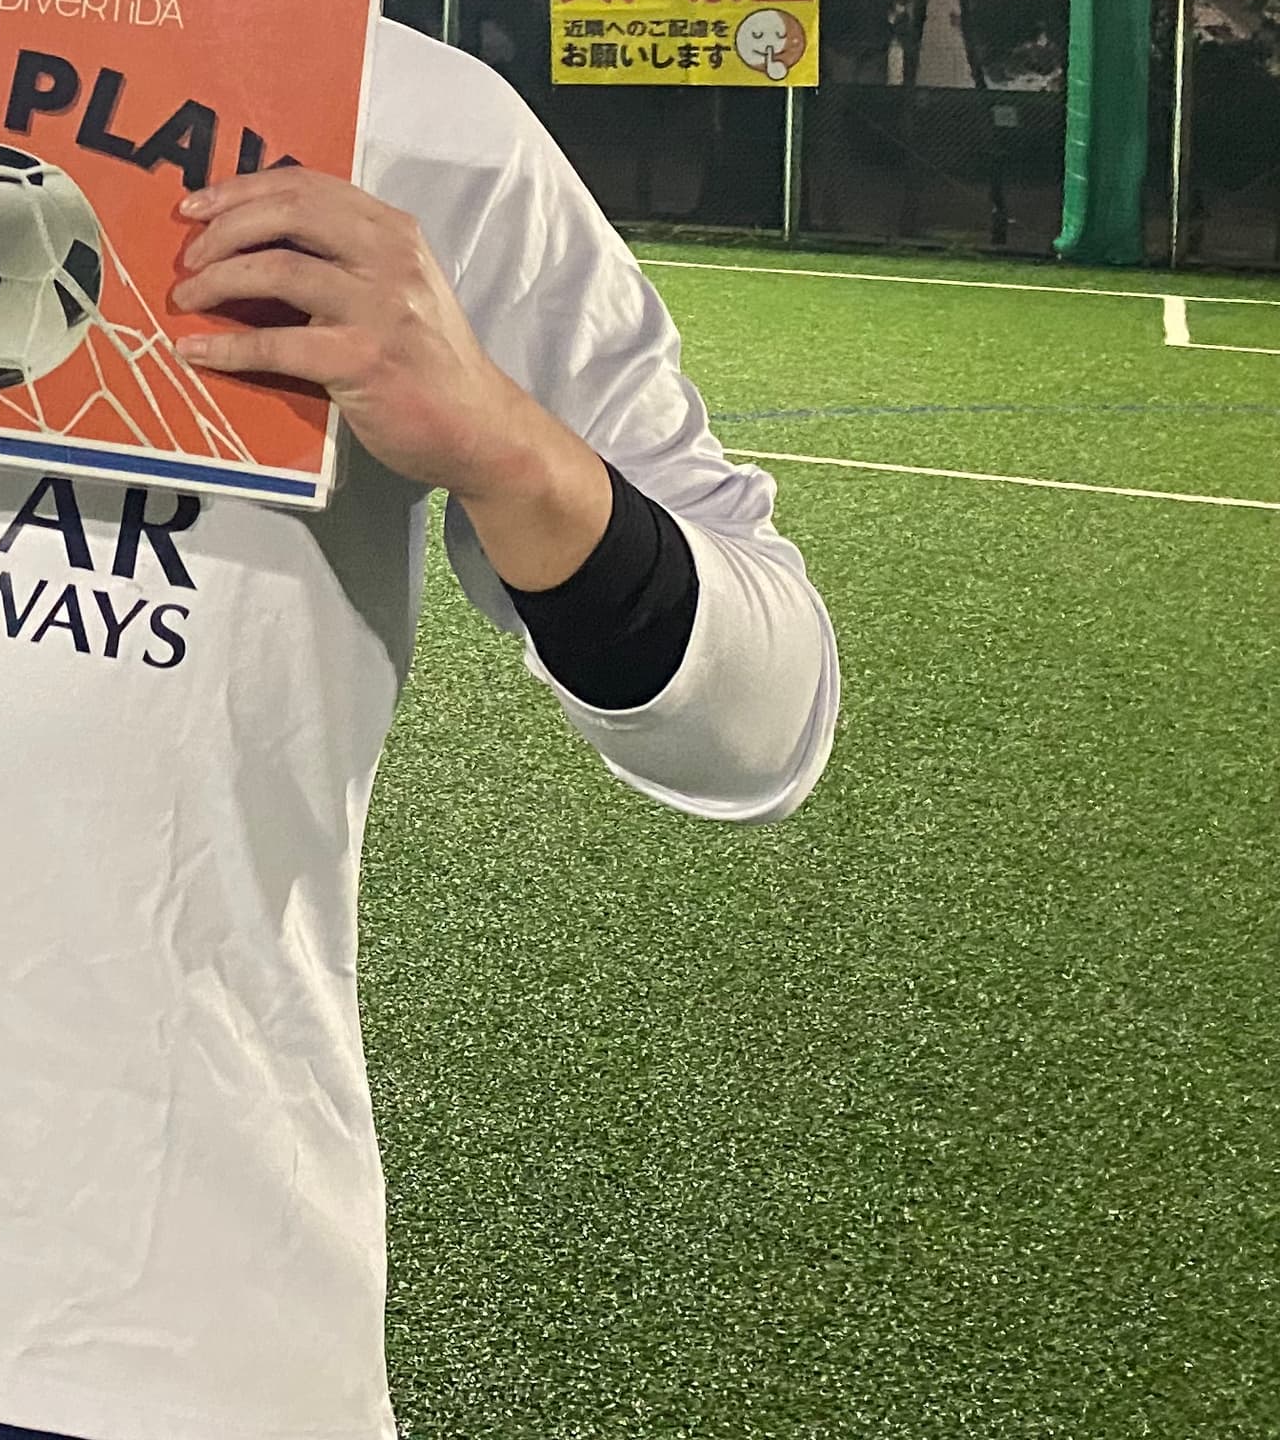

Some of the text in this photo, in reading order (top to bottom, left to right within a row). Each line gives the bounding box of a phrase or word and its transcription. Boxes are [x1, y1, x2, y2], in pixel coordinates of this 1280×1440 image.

[563, 18, 731, 39] 近隣へのご配慮を
[561, 42, 732, 70] お願いします
